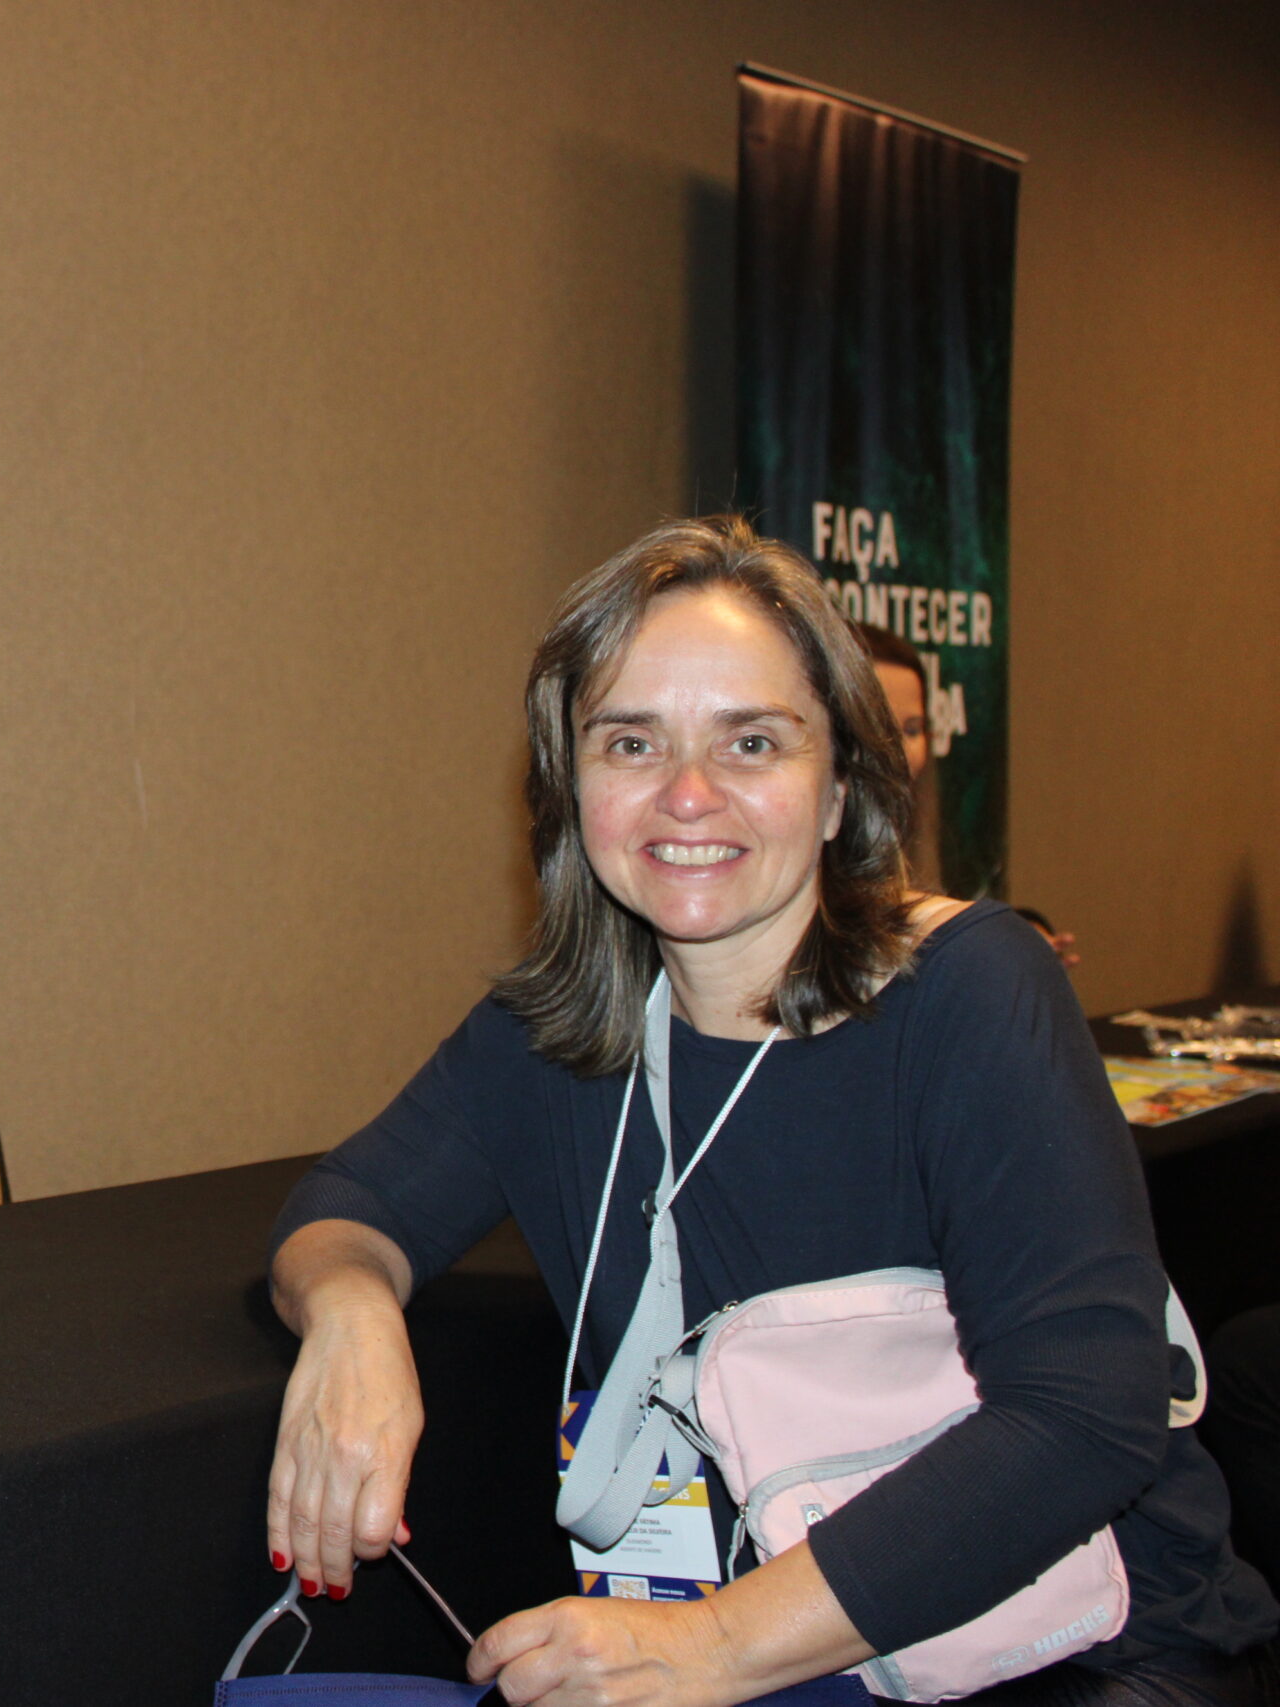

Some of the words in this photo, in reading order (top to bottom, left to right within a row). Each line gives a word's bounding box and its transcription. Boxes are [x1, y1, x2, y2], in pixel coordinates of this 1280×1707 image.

[813, 501, 899, 583] FAÇA
[823, 578, 992, 647] ONTECER
[1033, 1604, 1111, 1656] HOCKS
